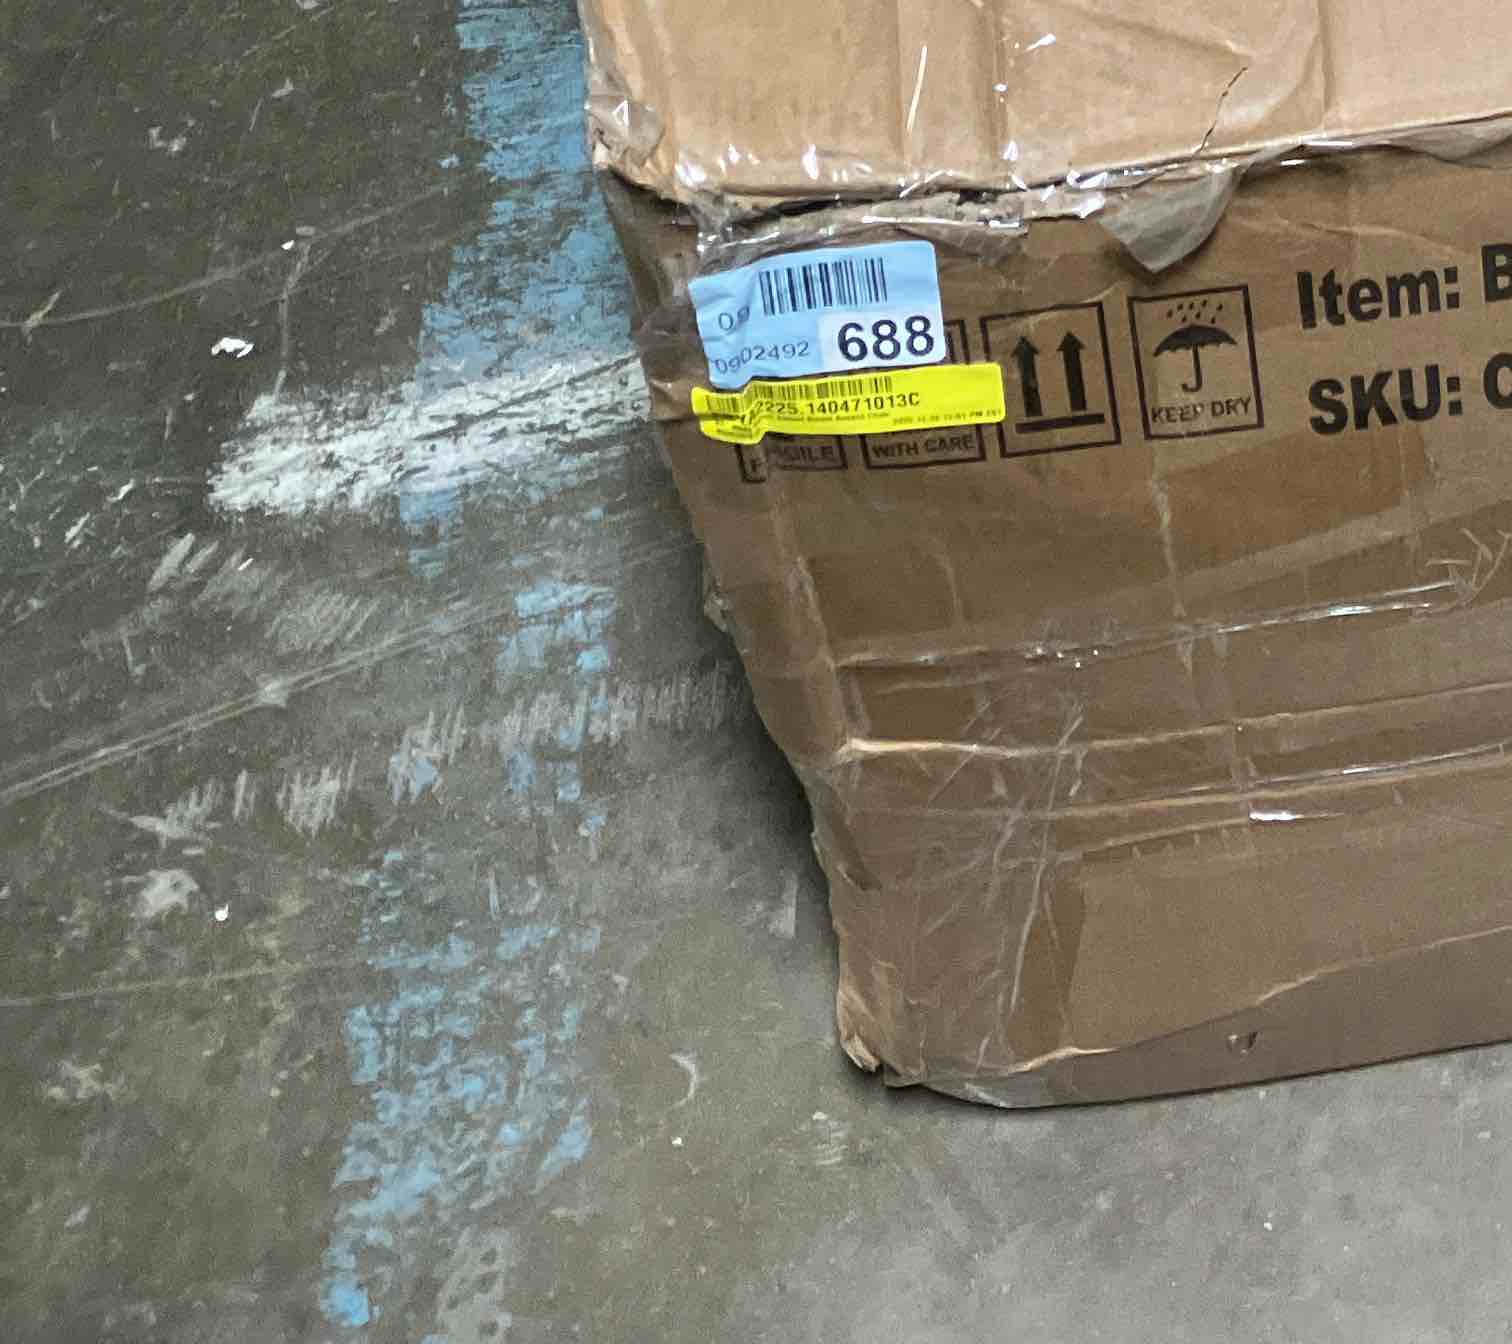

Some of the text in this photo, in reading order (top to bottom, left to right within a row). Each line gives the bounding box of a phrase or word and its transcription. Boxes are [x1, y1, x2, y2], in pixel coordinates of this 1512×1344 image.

[1296, 264, 1461, 330] Item:
[836, 314, 937, 364] 688
[1150, 395, 1253, 426] KEEP DRY
[1307, 363, 1463, 436] SKU:
[871, 433, 979, 460] WITH CARE
